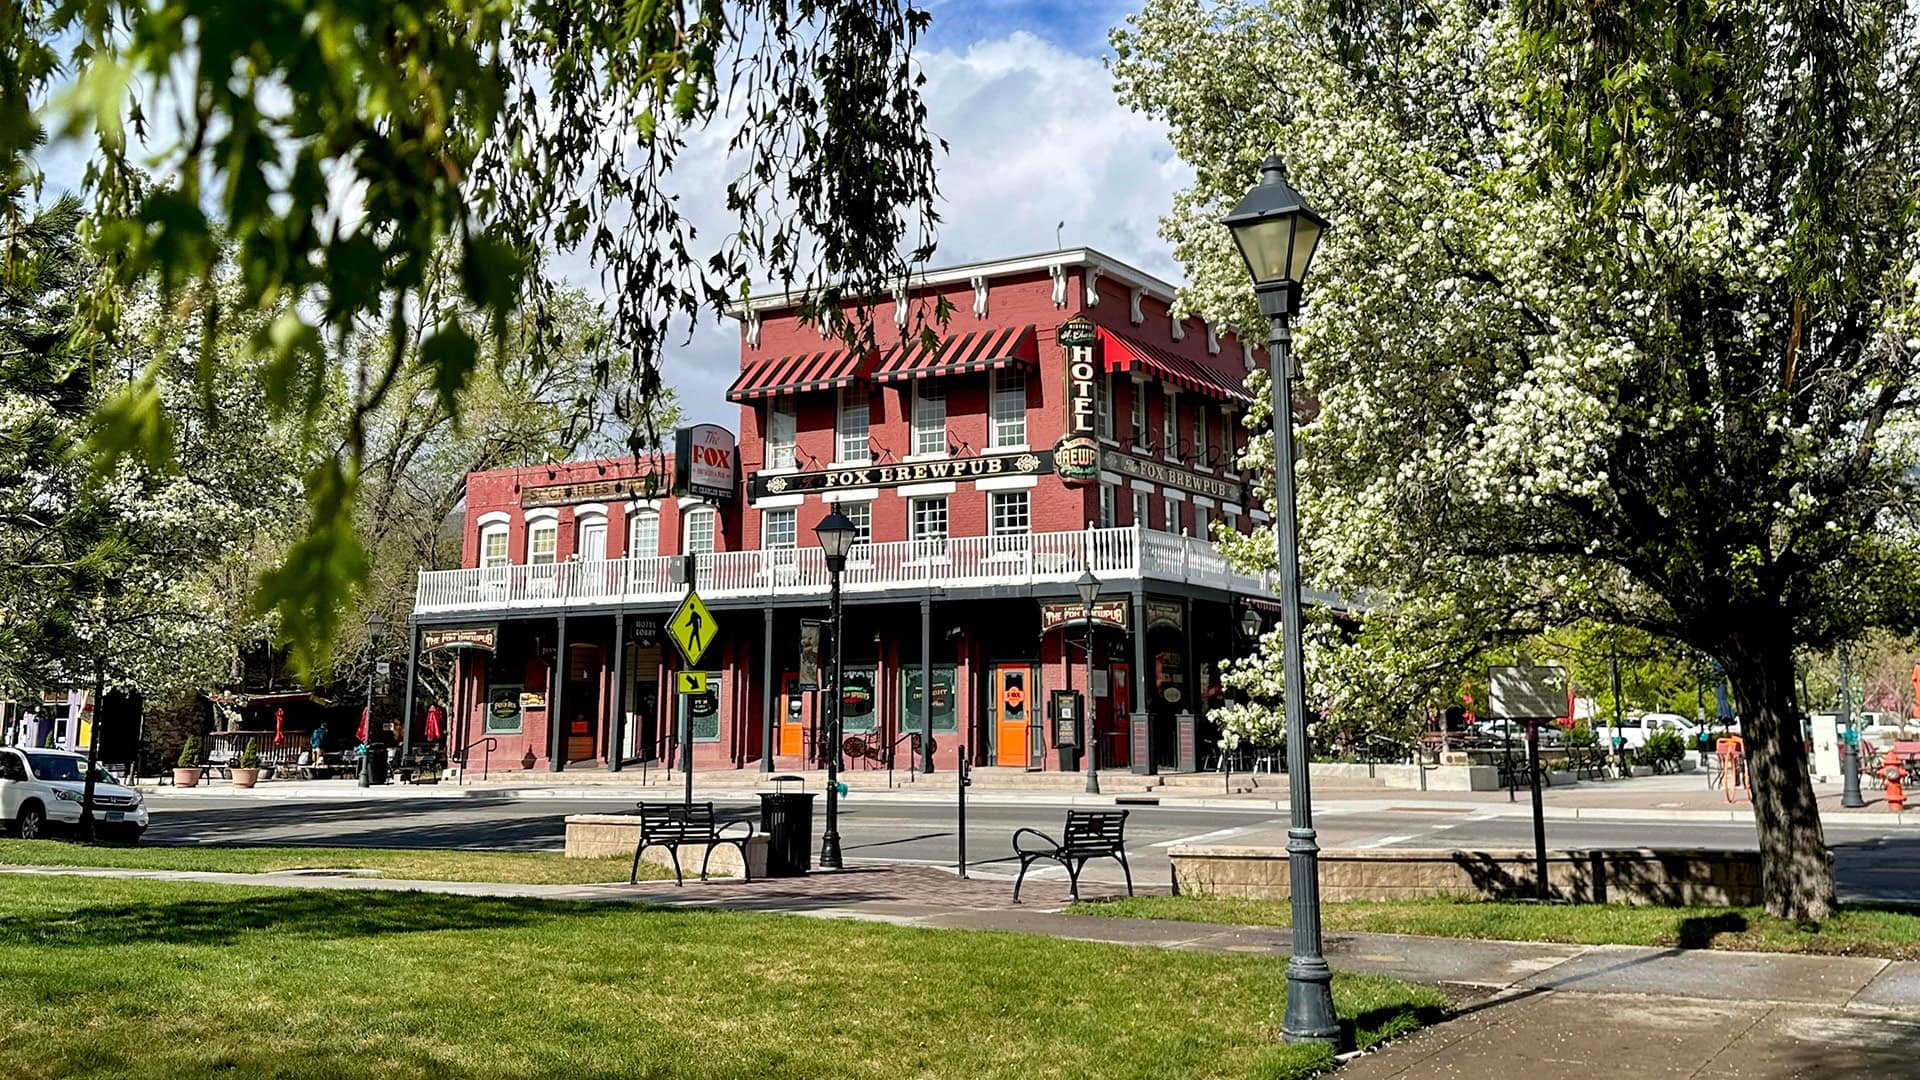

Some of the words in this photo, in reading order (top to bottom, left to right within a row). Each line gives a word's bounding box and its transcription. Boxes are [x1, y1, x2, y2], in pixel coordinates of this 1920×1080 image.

[1071, 345, 1094, 431] HOTEL
[705, 430, 720, 445] The
[693, 444, 730, 469] FOX
[825, 469, 871, 487] FOX
[879, 458, 1002, 482] BREWPUB
[1139, 462, 1164, 480] FOX
[1168, 470, 1226, 496] BREWPUB
[1045, 610, 1062, 626] THE
[1064, 609, 1080, 620] FOX
[425, 636, 440, 648] THE
